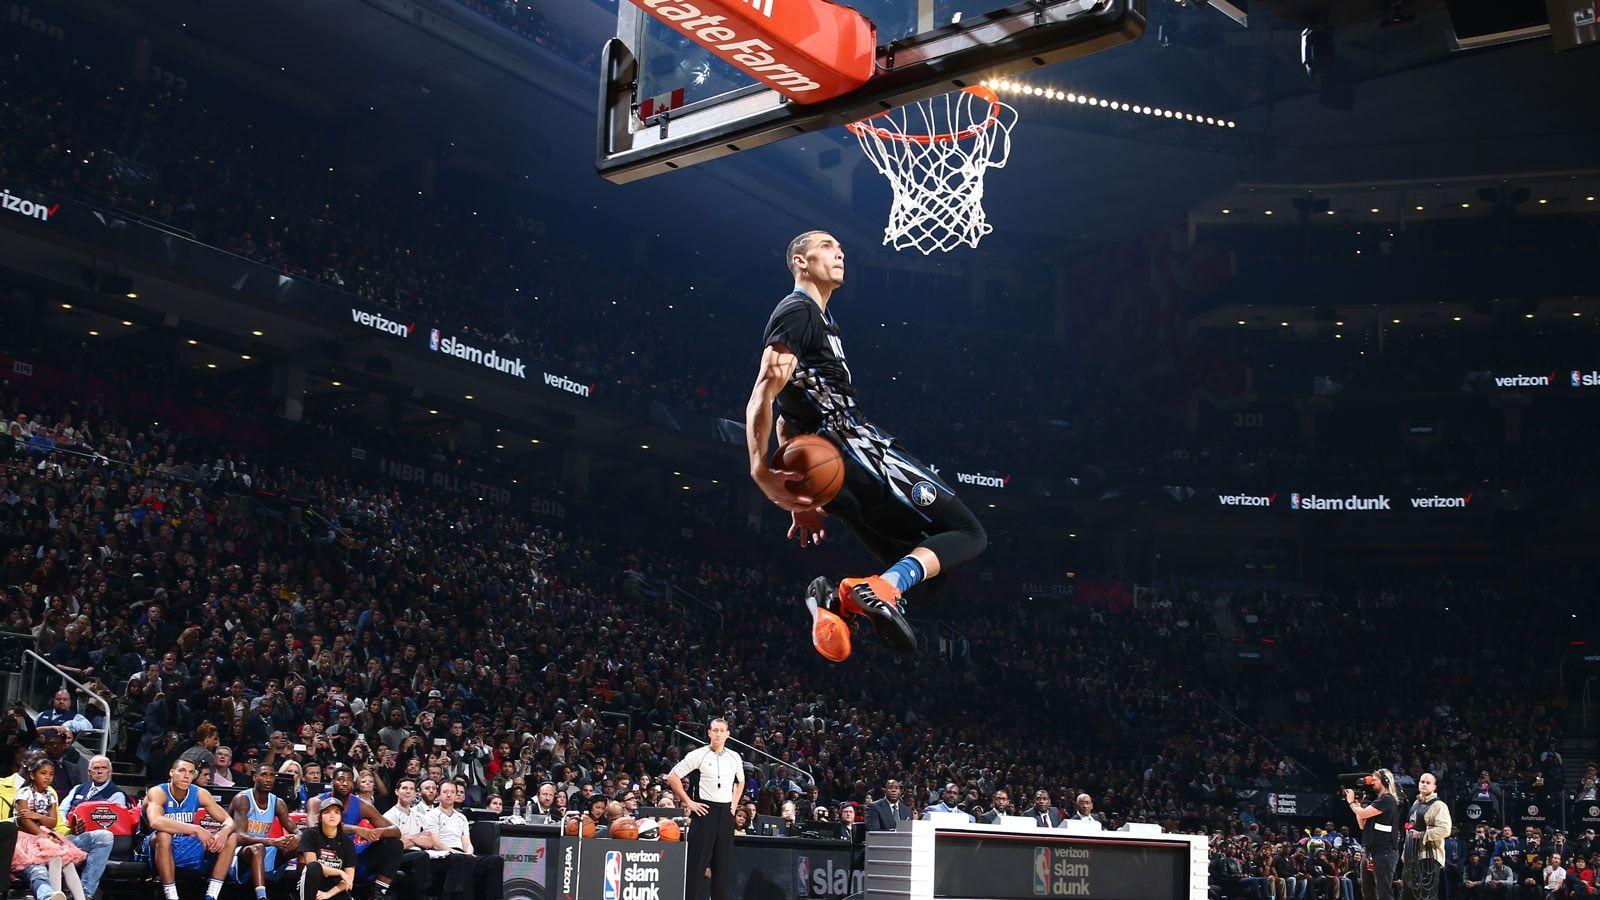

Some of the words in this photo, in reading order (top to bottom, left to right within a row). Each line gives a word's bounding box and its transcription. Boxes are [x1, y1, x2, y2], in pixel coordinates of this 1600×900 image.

[352, 308, 407, 337] verizon
[440, 336, 482, 364] slam
[484, 350, 526, 378] dunk
[544, 372, 589, 397] verizon
[1495, 374, 1549, 387] verizon
[957, 473, 1004, 488] verizon
[1219, 494, 1270, 506] verizon
[1301, 495, 1343, 510] slam
[1345, 495, 1391, 510] dunk
[1410, 496, 1465, 508] verizon
[625, 850, 660, 862] verizon
[1054, 847, 1089, 858] verizon
[563, 846, 573, 894] verizon
[624, 863, 659, 882] slam
[1054, 859, 1089, 877] slam
[622, 882, 660, 900] dunk
[1053, 877, 1090, 896] dunk
